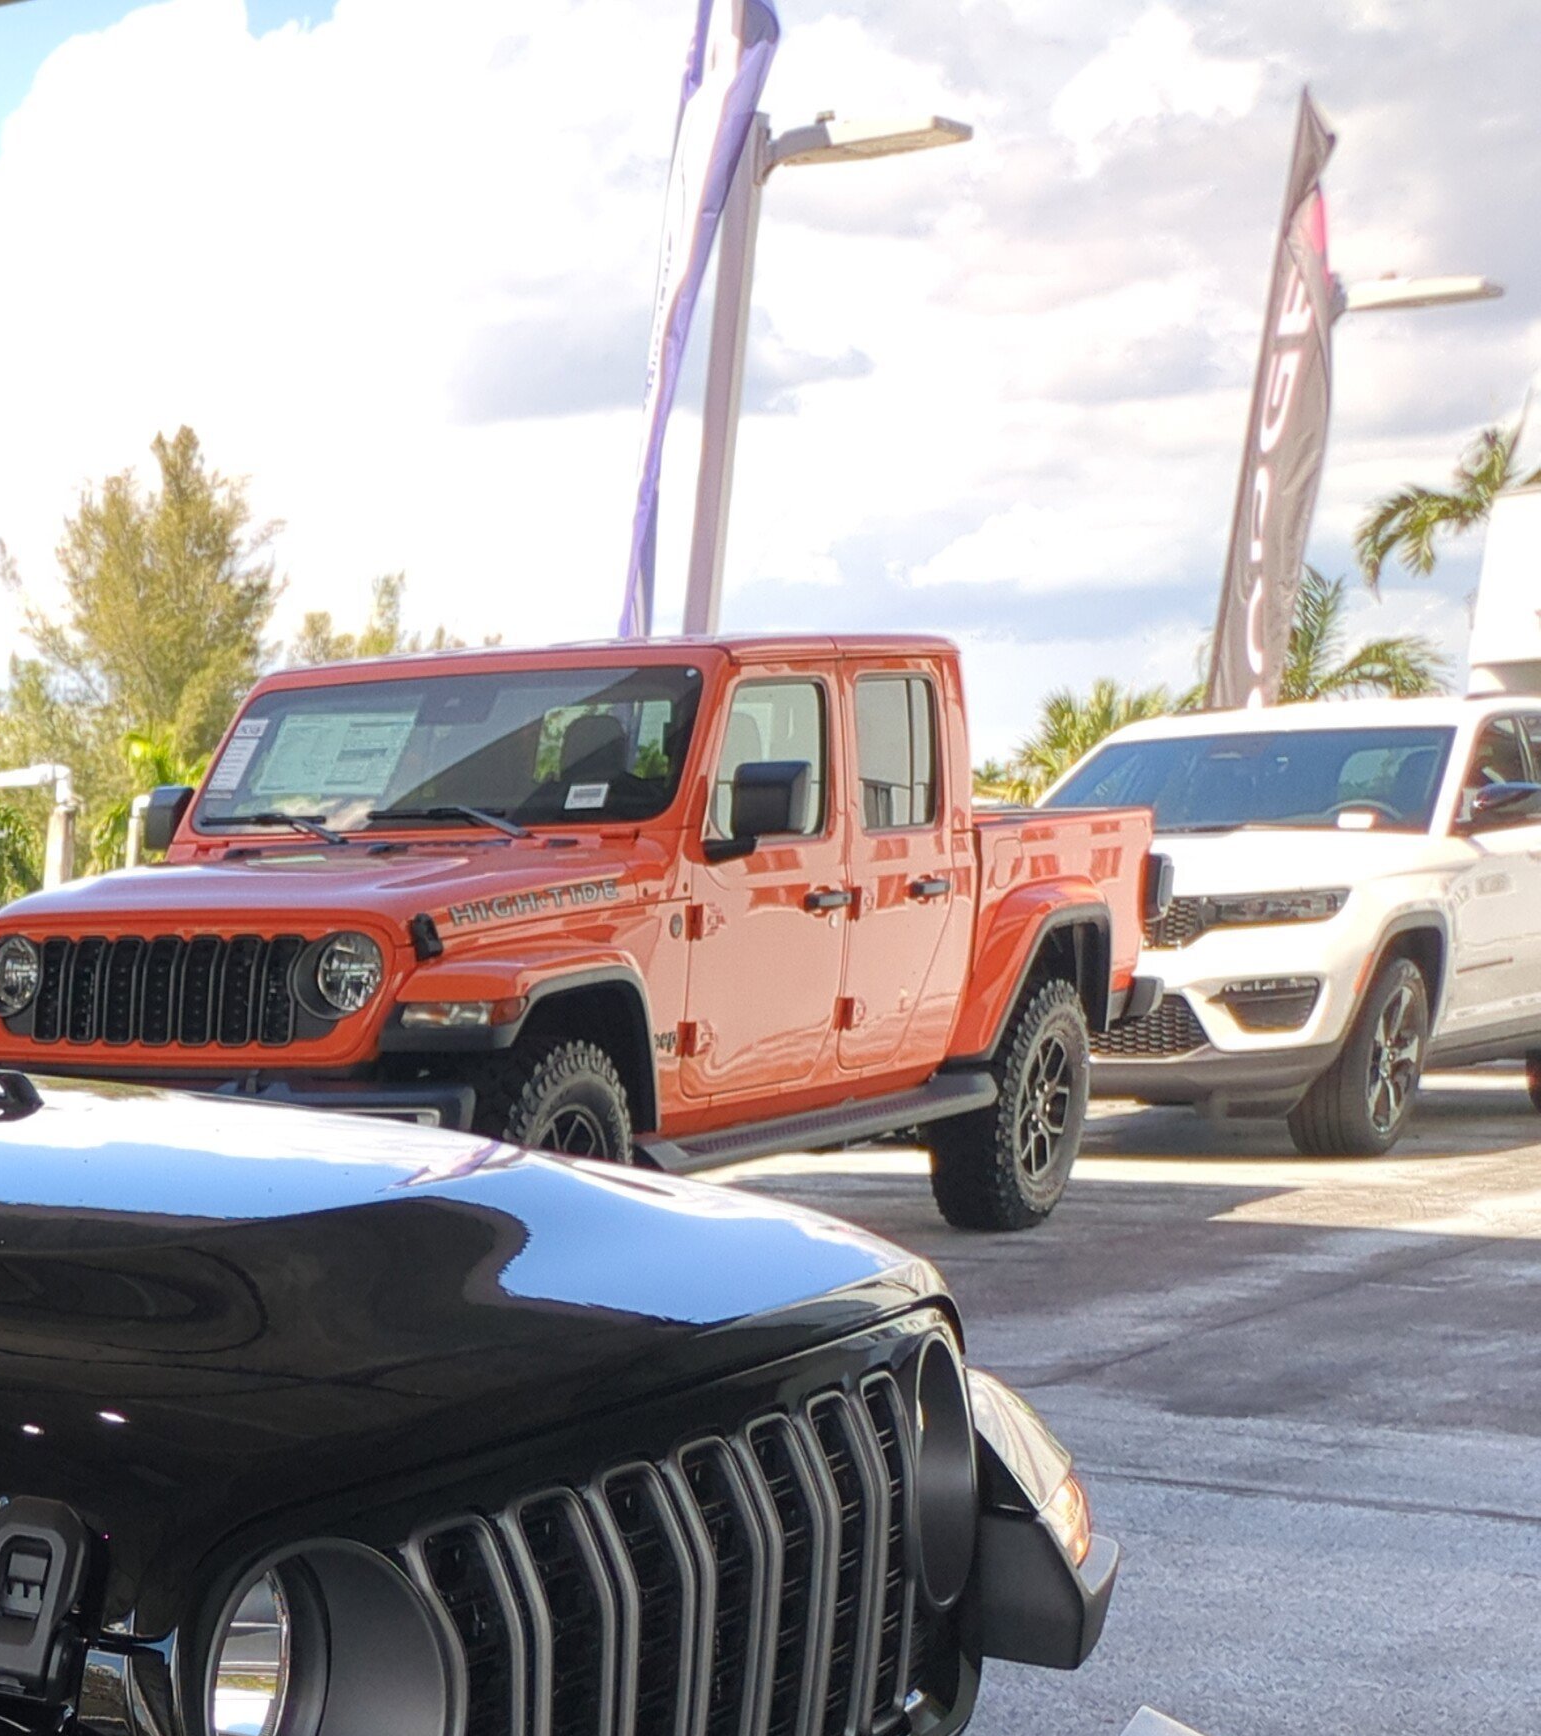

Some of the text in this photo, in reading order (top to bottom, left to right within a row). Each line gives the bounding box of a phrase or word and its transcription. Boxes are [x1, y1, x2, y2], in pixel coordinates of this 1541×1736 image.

[449, 878, 620, 927] HIGH TIDE
[653, 1030, 677, 1053] eep
